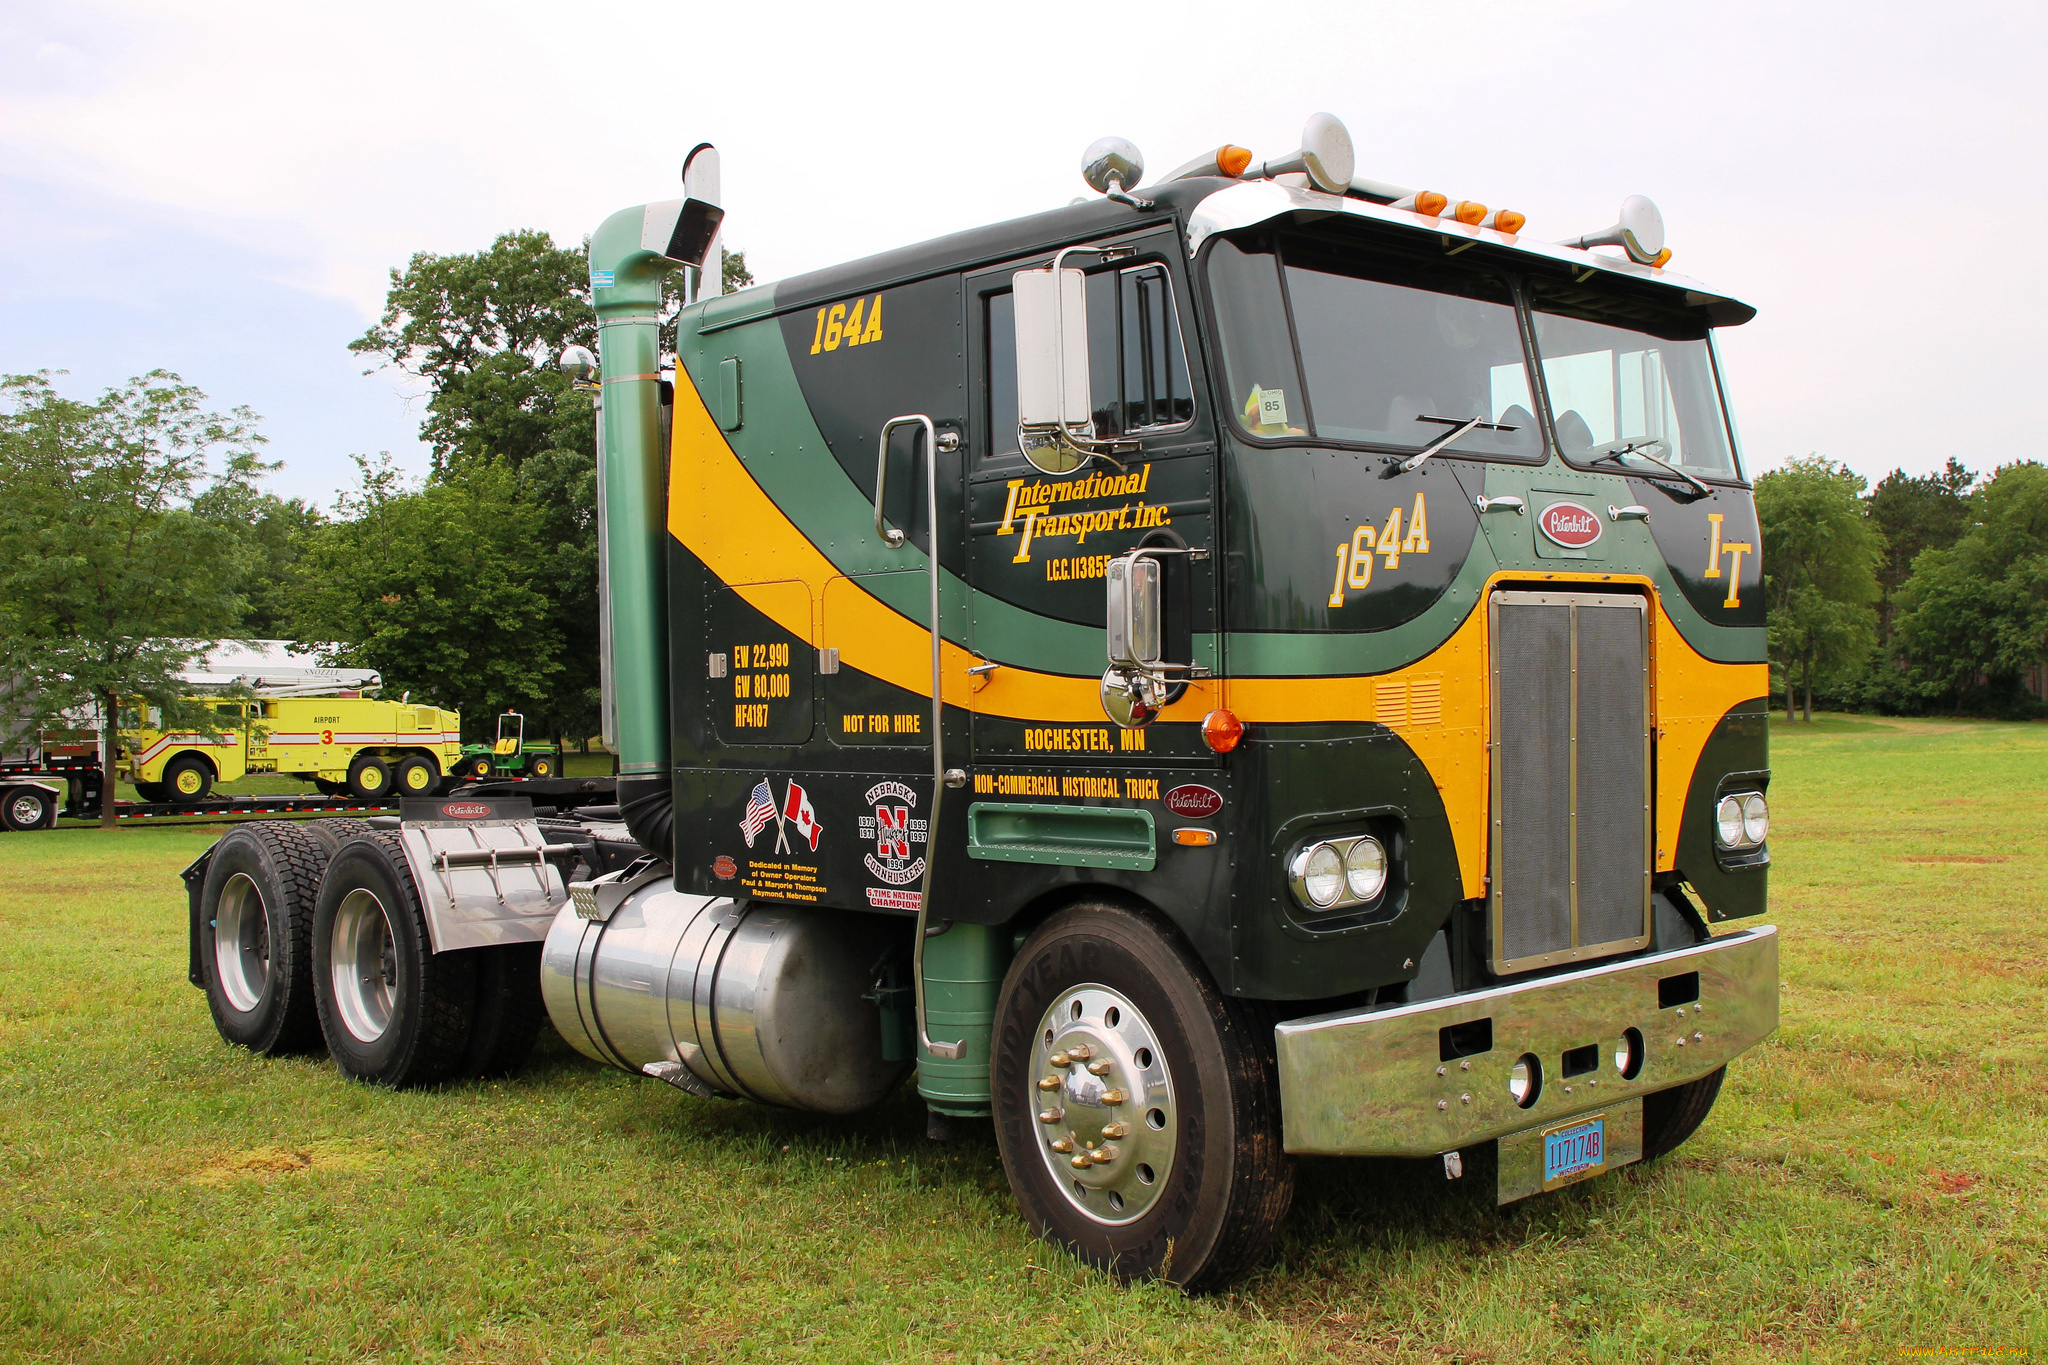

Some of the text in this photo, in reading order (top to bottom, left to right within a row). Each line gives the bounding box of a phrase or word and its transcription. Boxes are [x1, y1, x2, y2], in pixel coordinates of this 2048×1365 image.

[810, 294, 883, 355] 164A
[1265, 401, 1280, 411] 85
[997, 464, 1151, 535] International
[1551, 511, 1594, 534] Peterbilt
[1328, 492, 1430, 607] 164A
[734, 643, 789, 670] EW 22,990
[304, 668, 340, 676] SNOZZLE
[735, 673, 790, 700] GW 80,000
[735, 704, 769, 727] HF4187
[843, 714, 921, 733] NOT FOR HIRE
[321, 729, 333, 745] 3
[1024, 728, 1146, 753] ROCHESTER, MN
[866, 782, 916, 807] NEBRASKA
[974, 774, 1160, 800] NON-COMMERCIAL HISTORICAL TRUCK
[1168, 790, 1217, 809] Peterbilt
[448, 804, 486, 815] Peterbilt
[859, 816, 875, 827] 1970
[909, 819, 927, 831] 1995
[860, 828, 875, 839] 1971
[910, 831, 927, 842] 1997
[749, 861, 782, 870] Dedicated
[792, 864, 818, 873] Memory
[865, 853, 925, 884] CORNHUSKERS
[887, 859, 904, 869] 1994
[760, 871, 782, 879] Owner
[784, 873, 816, 882] Operators
[741, 879, 756, 887] Paul
[765, 881, 793, 890] Marjorie
[795, 883, 827, 893] Thompson
[752, 889, 818, 902] Raymond, Nebraska
[892, 891, 921, 901] NATIONA
[1561, 1124, 1589, 1138] COLLECTOR
[1550, 1131, 1600, 1170] 117174B
[1559, 1162, 1590, 1177] WISCONSIN
